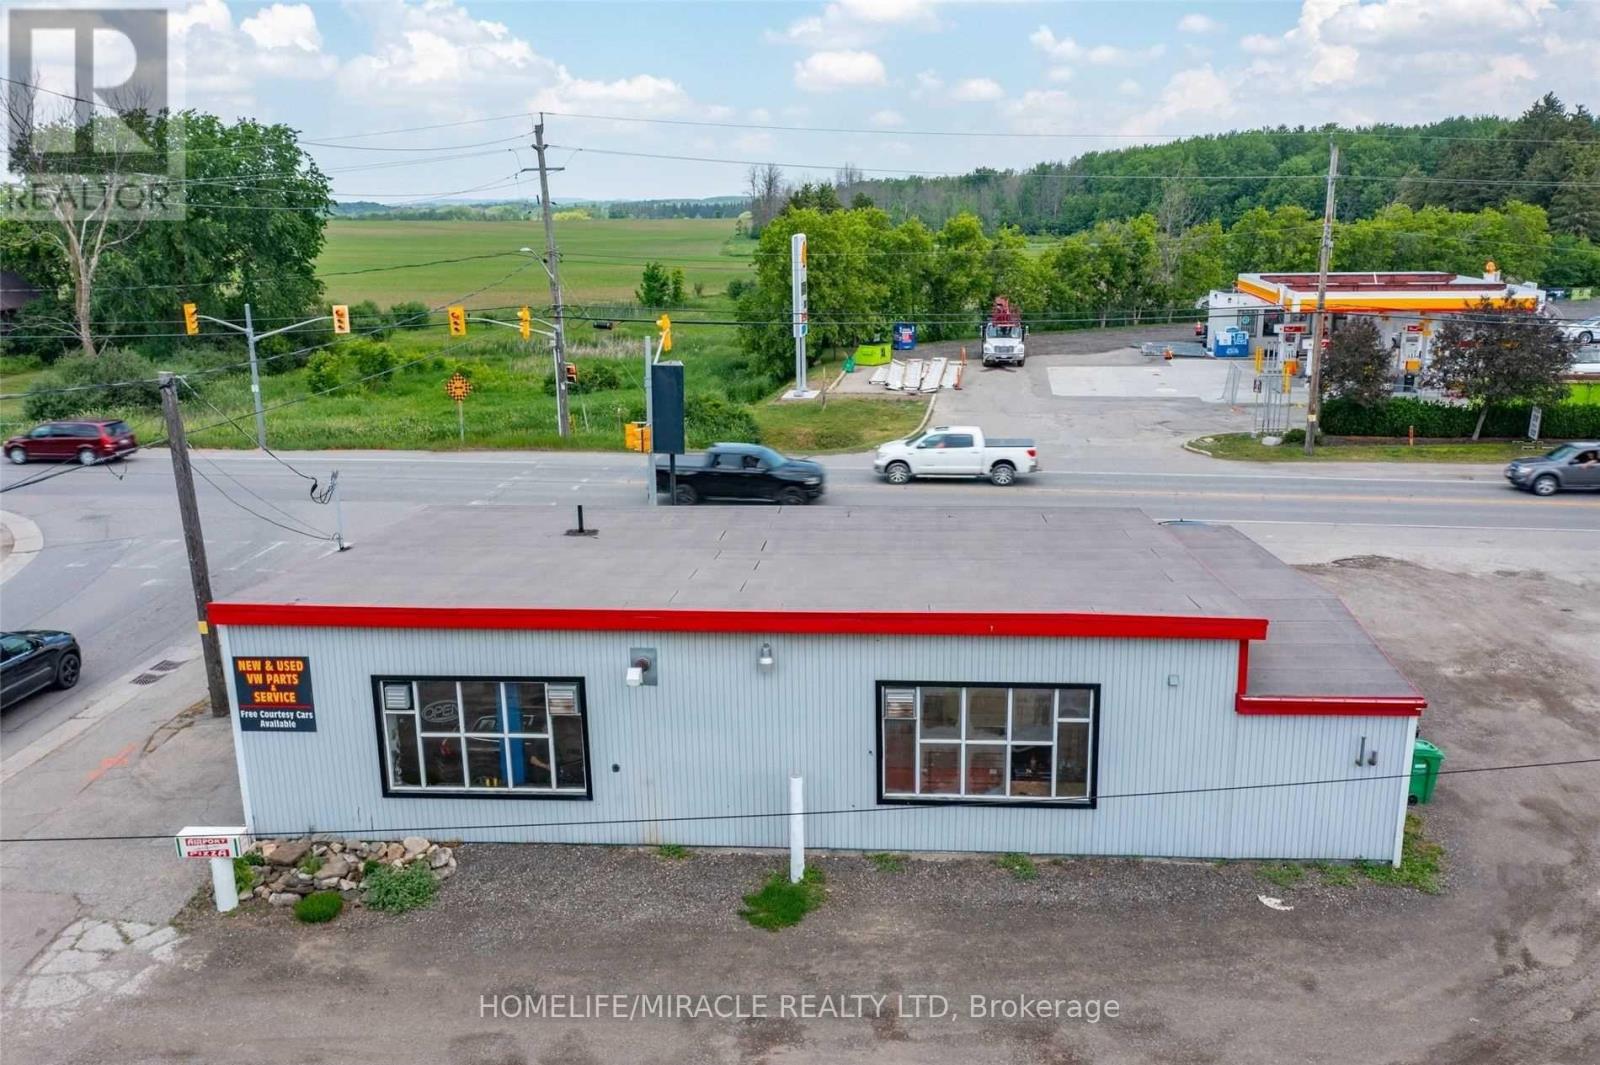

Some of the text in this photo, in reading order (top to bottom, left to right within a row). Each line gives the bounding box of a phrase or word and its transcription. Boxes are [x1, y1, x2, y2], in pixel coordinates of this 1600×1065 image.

[237, 660, 304, 671] NEW & USED
[246, 673, 299, 685] VW PARTS
[254, 691, 297, 703] SERVICE
[240, 710, 314, 719] Free Courtesy Cars
[260, 720, 297, 728] Available
[187, 838, 226, 846] AIRPORT
